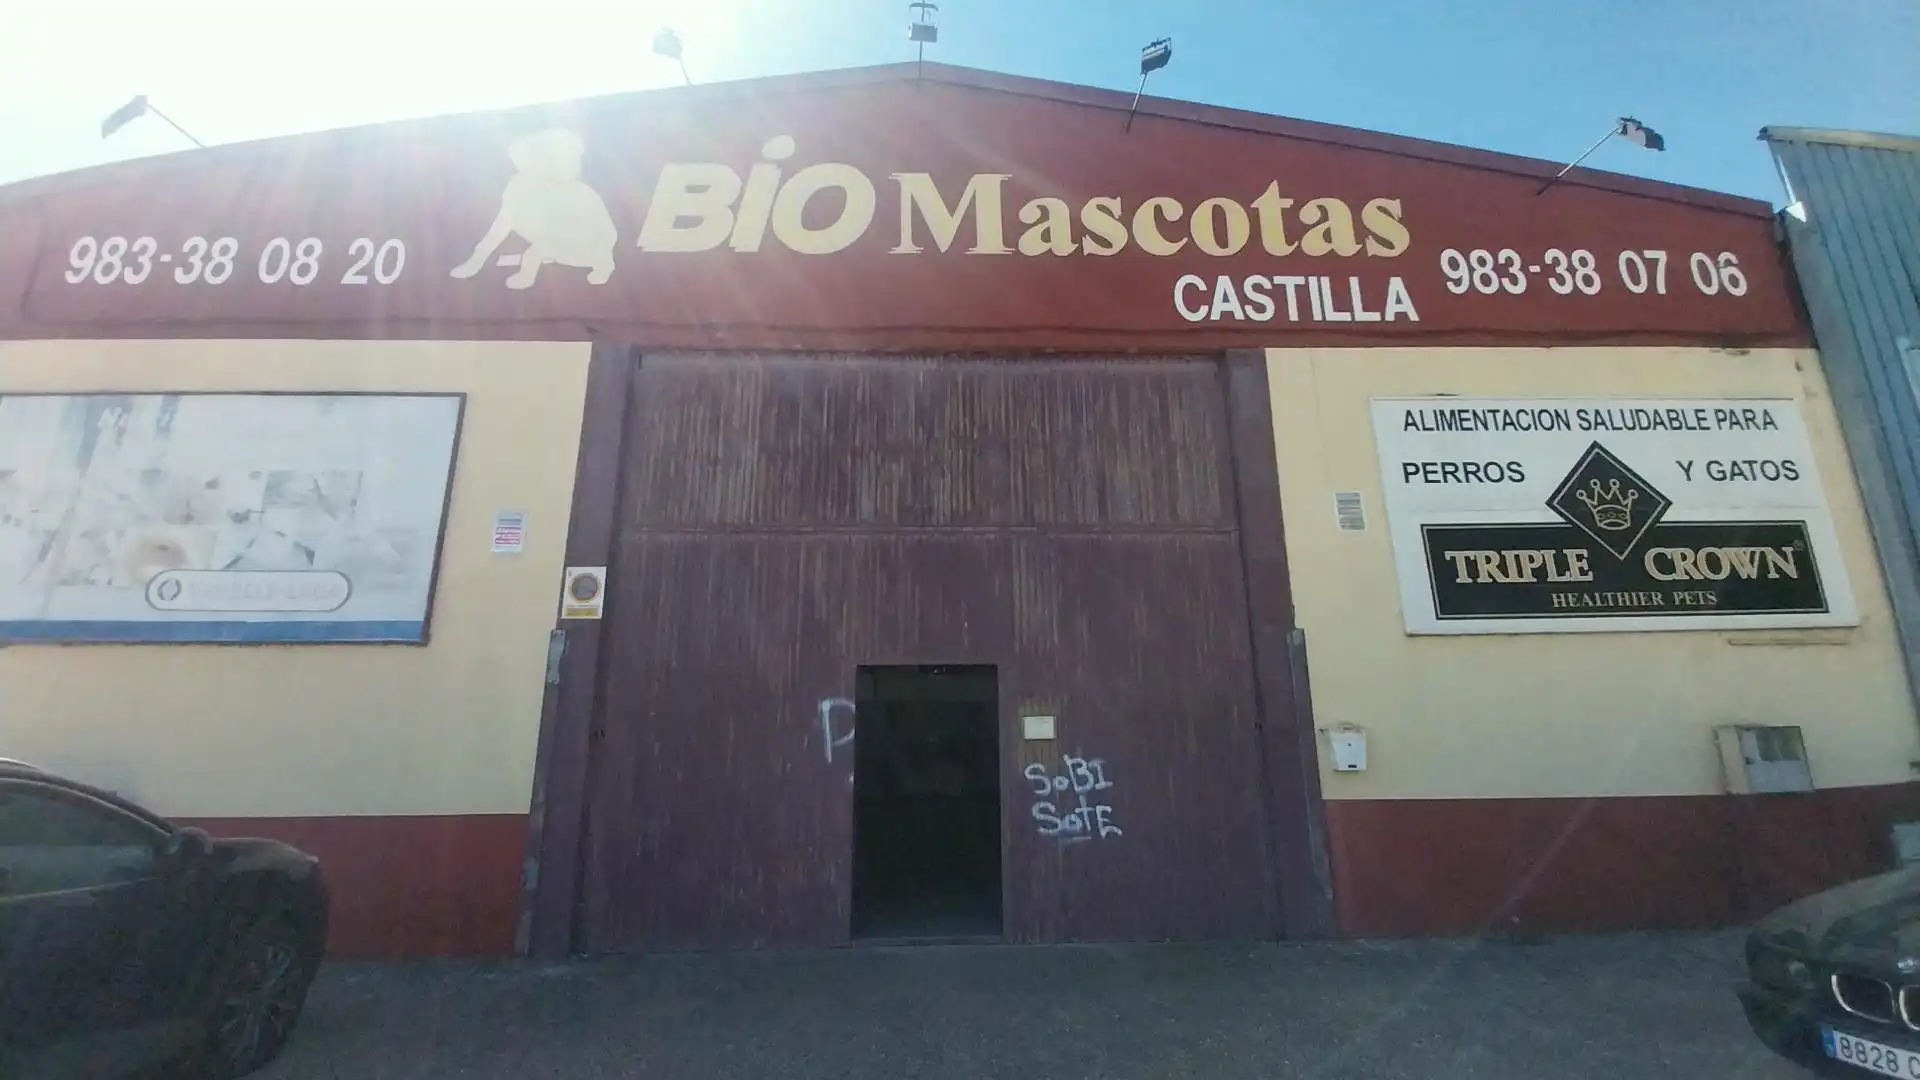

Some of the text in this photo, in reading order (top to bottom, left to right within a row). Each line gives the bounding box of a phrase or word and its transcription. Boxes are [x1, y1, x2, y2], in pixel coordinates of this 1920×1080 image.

[887, 171, 1411, 259] Mascotas
[64, 236, 406, 286] 983-38 08 20
[1440, 248, 1747, 297] 983-38 07 06
[1173, 274, 1420, 323] CASTILLA
[1403, 408, 1779, 432] ALIMENTACION SALUDABLE PARA
[1402, 460, 1526, 485] PERROS
[1676, 458, 1801, 483] Y GATOS
[1444, 544, 1799, 585] TRIPLE CROWN
[1551, 590, 1718, 609] HEALTHIER PETS
[1839, 1036, 1900, 1073] 8828
